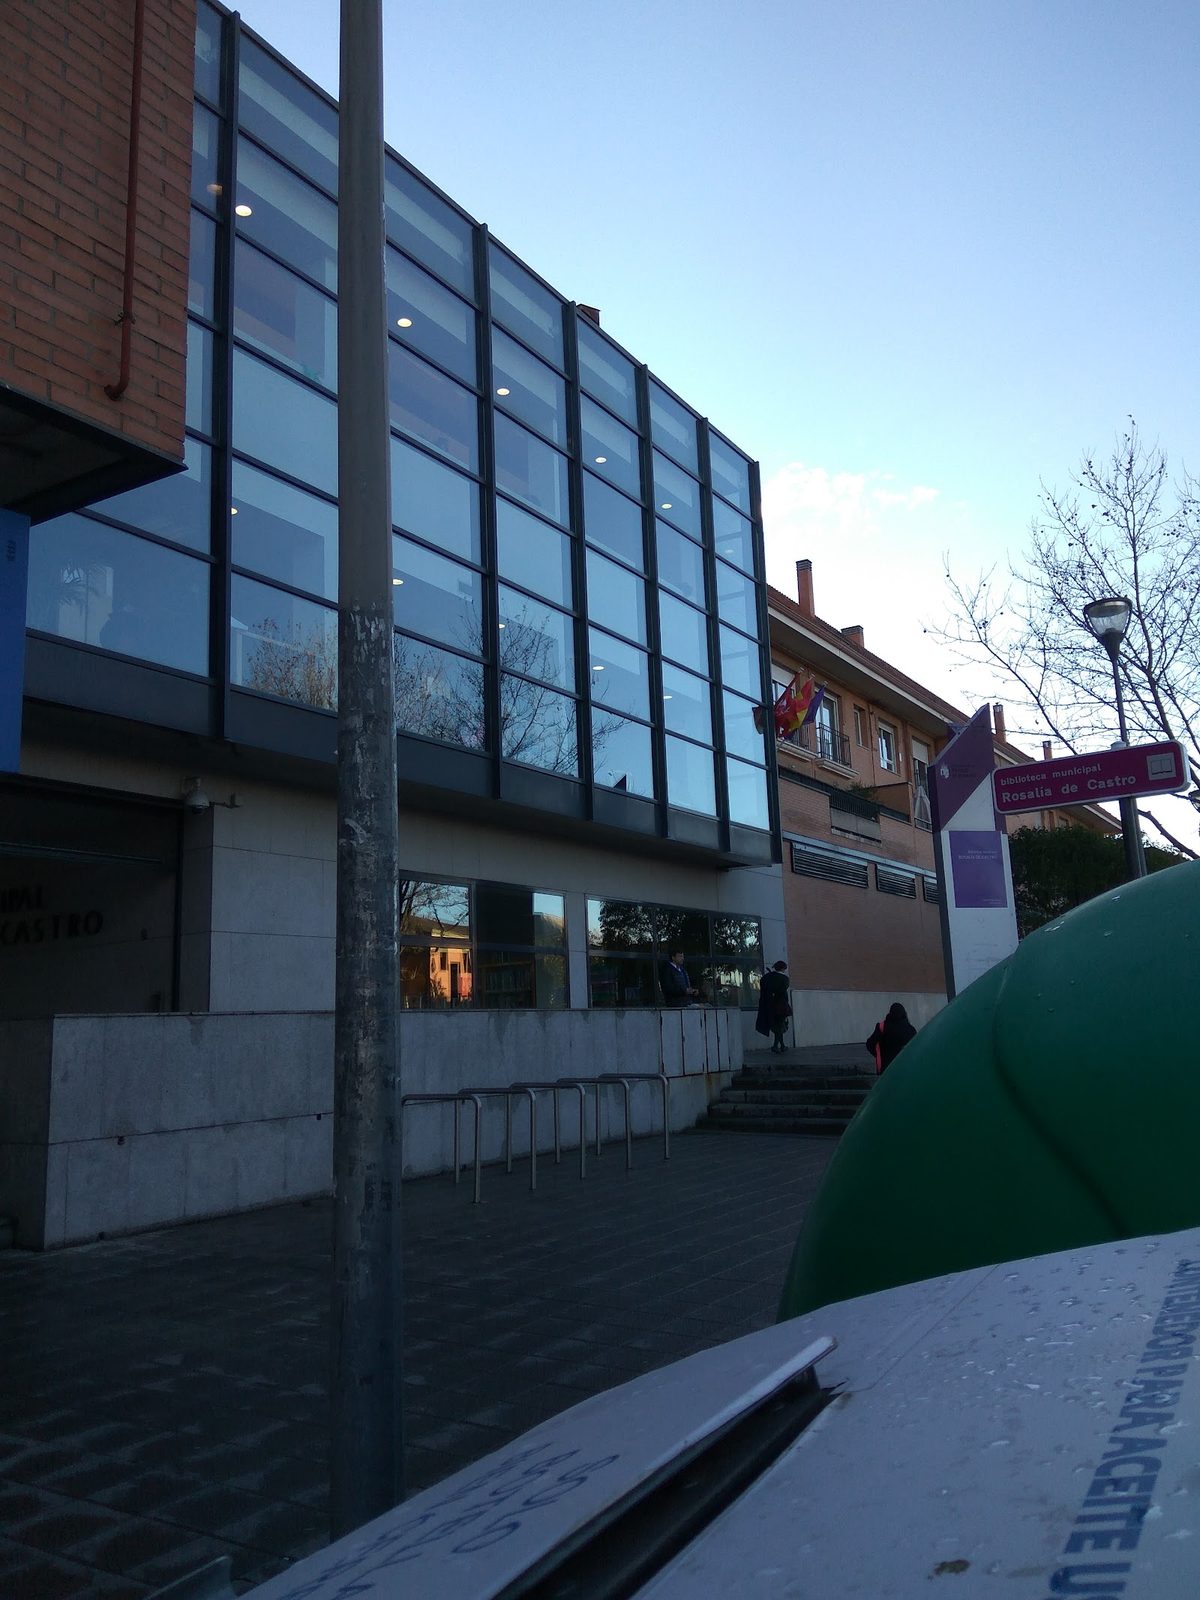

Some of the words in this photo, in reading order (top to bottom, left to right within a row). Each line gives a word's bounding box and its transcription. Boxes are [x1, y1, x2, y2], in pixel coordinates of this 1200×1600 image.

[1000, 772, 1047, 786] biblioteca
[1052, 763, 1102, 778] municipal
[1061, 782, 1080, 796] de
[1087, 773, 1137, 791] Castro
[1112, 1363, 1188, 1433] PARA
[1064, 1436, 1167, 1554] ACEITE
